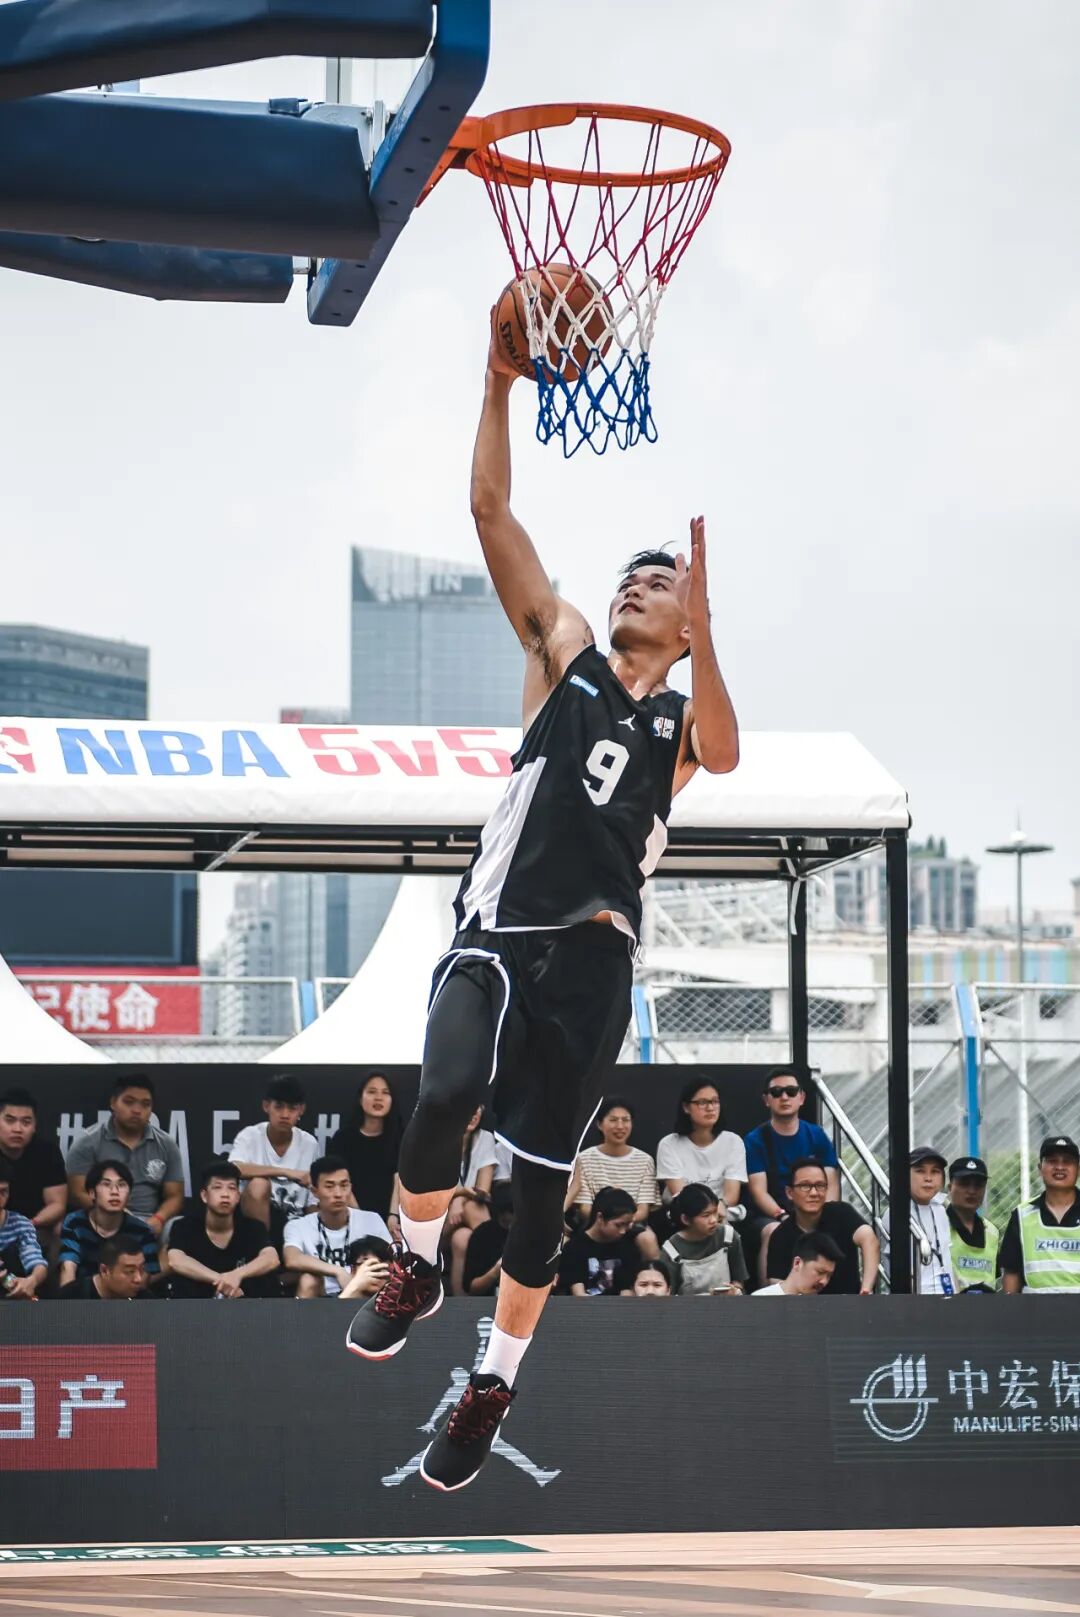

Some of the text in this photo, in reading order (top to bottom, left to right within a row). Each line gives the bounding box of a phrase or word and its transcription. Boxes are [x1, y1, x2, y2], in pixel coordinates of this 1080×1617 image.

[56, 728, 513, 778] NBA 5v5
[582, 739, 630, 806] 9
[953, 1416, 1080, 1433] MANULIFE-SIN
